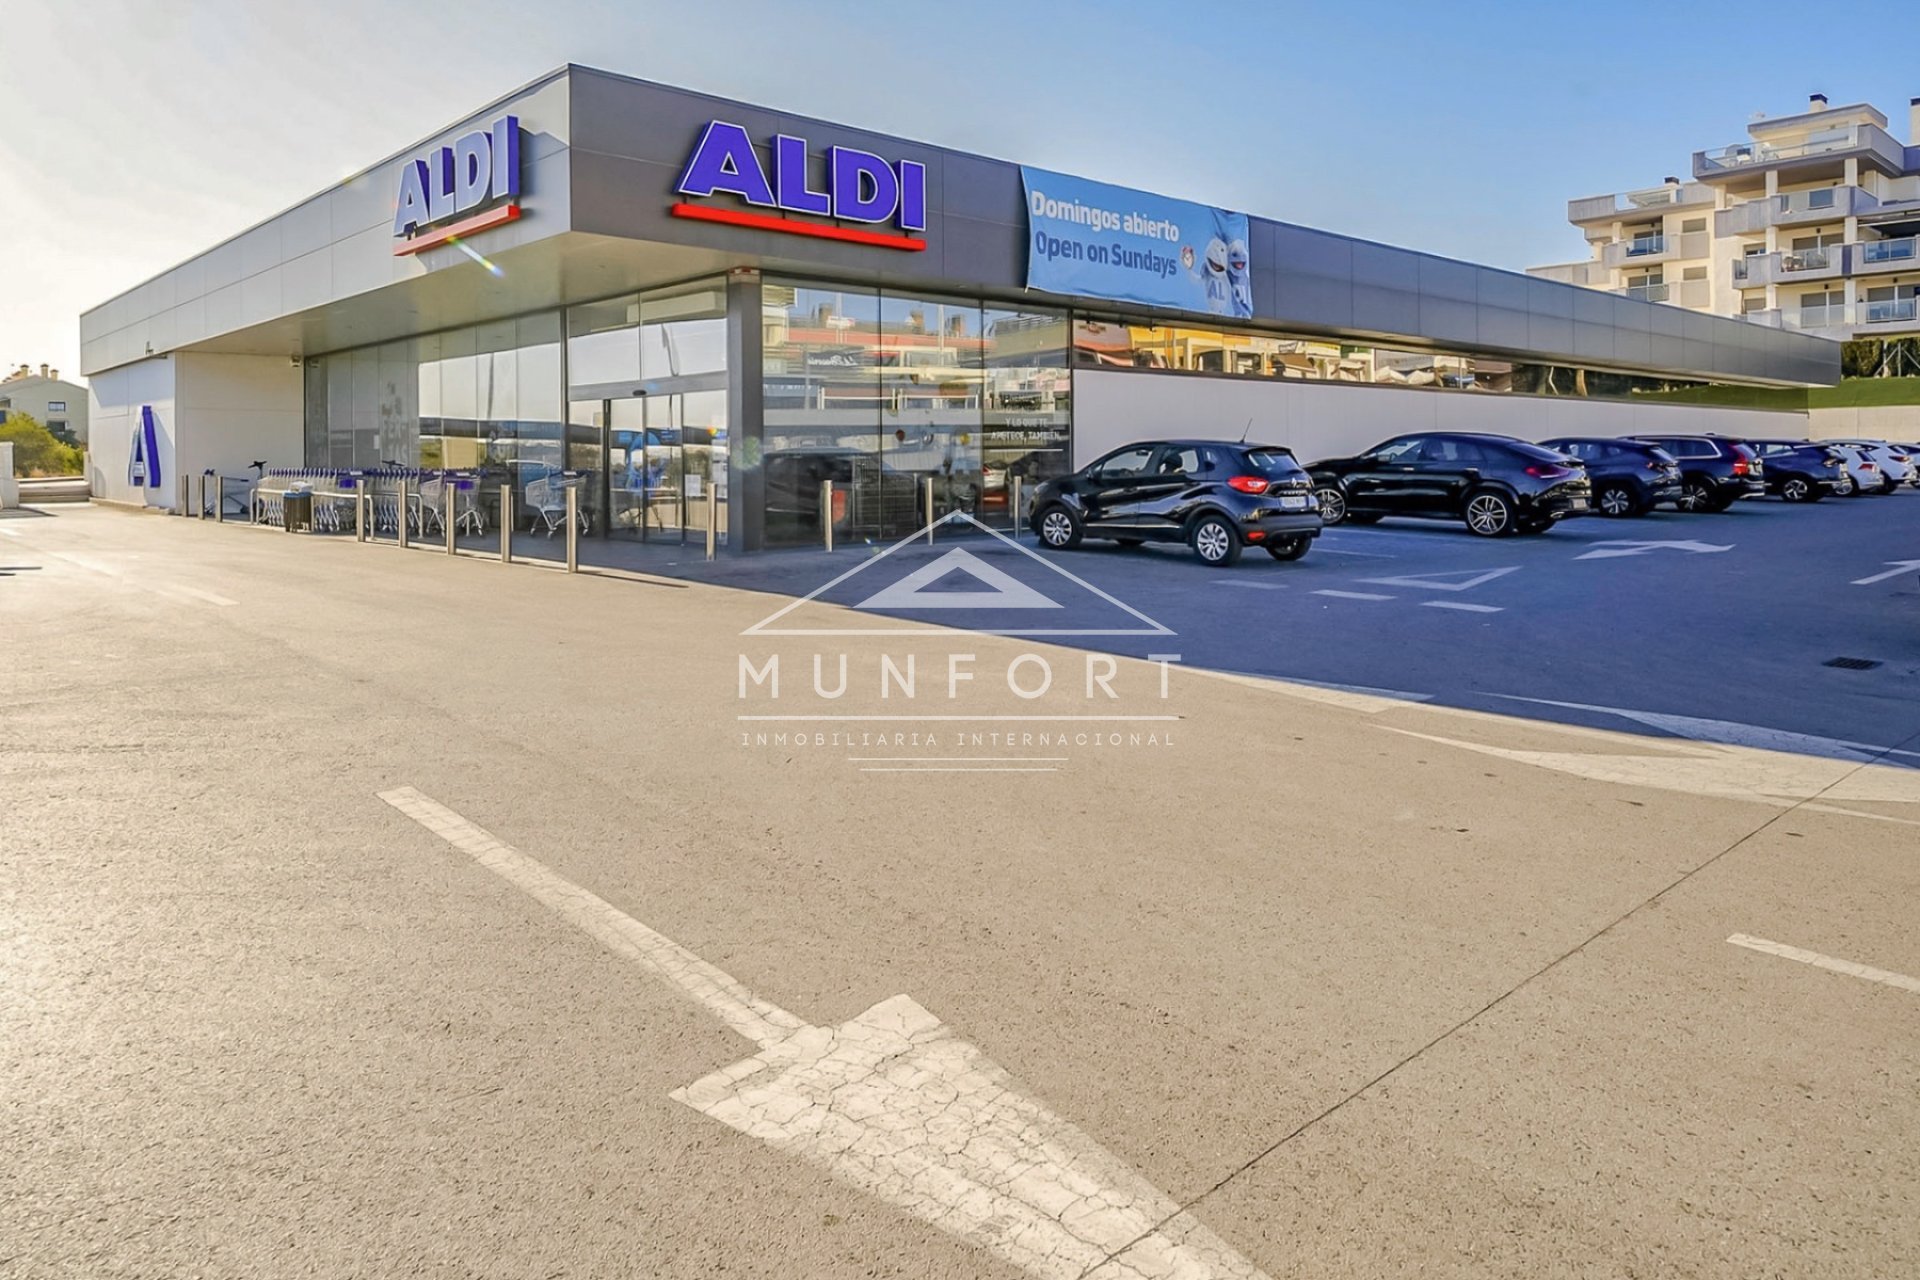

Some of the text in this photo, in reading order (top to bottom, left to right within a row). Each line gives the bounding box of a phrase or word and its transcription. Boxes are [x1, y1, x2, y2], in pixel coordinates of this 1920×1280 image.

[393, 115, 519, 238] ALDI
[674, 119, 926, 232] ALDI
[1030, 190, 1180, 243] Domingos abierto
[1035, 230, 1178, 279] Open on Sundays
